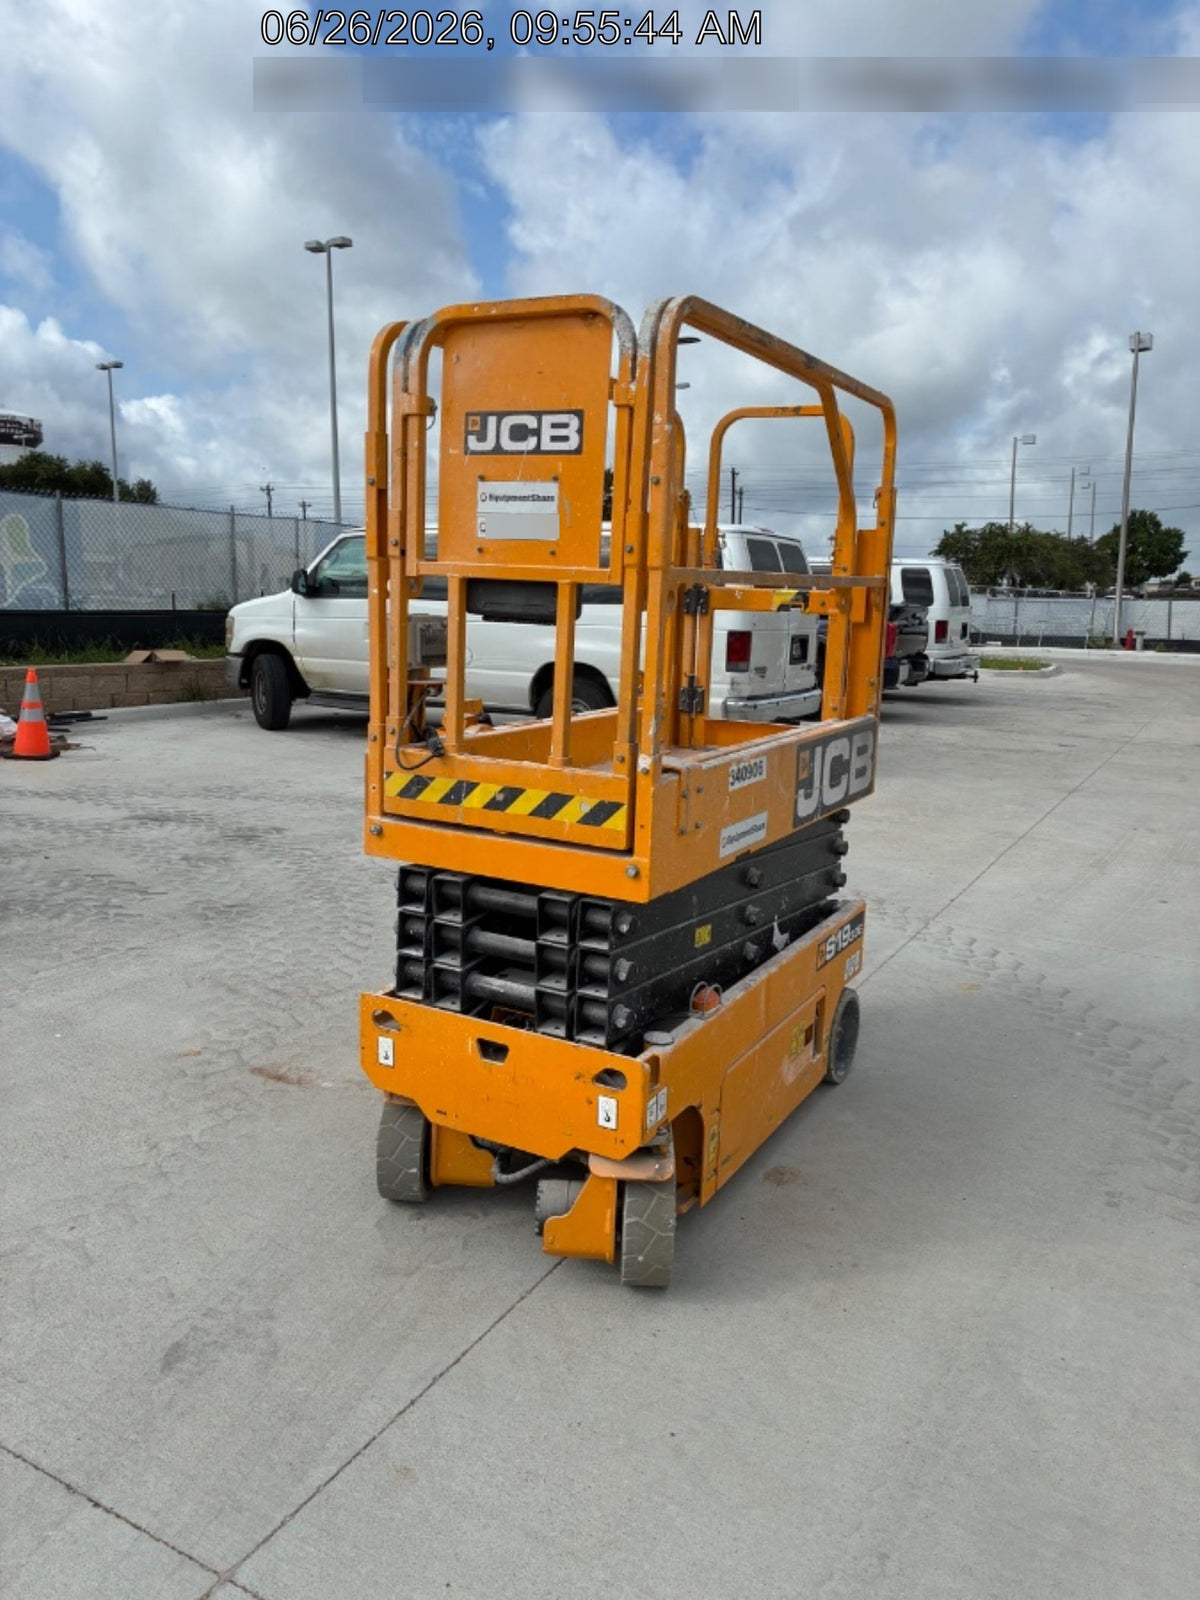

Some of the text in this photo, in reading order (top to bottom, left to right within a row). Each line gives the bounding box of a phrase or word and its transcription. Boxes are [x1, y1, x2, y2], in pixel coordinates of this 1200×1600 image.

[467, 413, 580, 451] JCB
[488, 492, 556, 505] EquipmentShare
[796, 729, 874, 818] JCB
